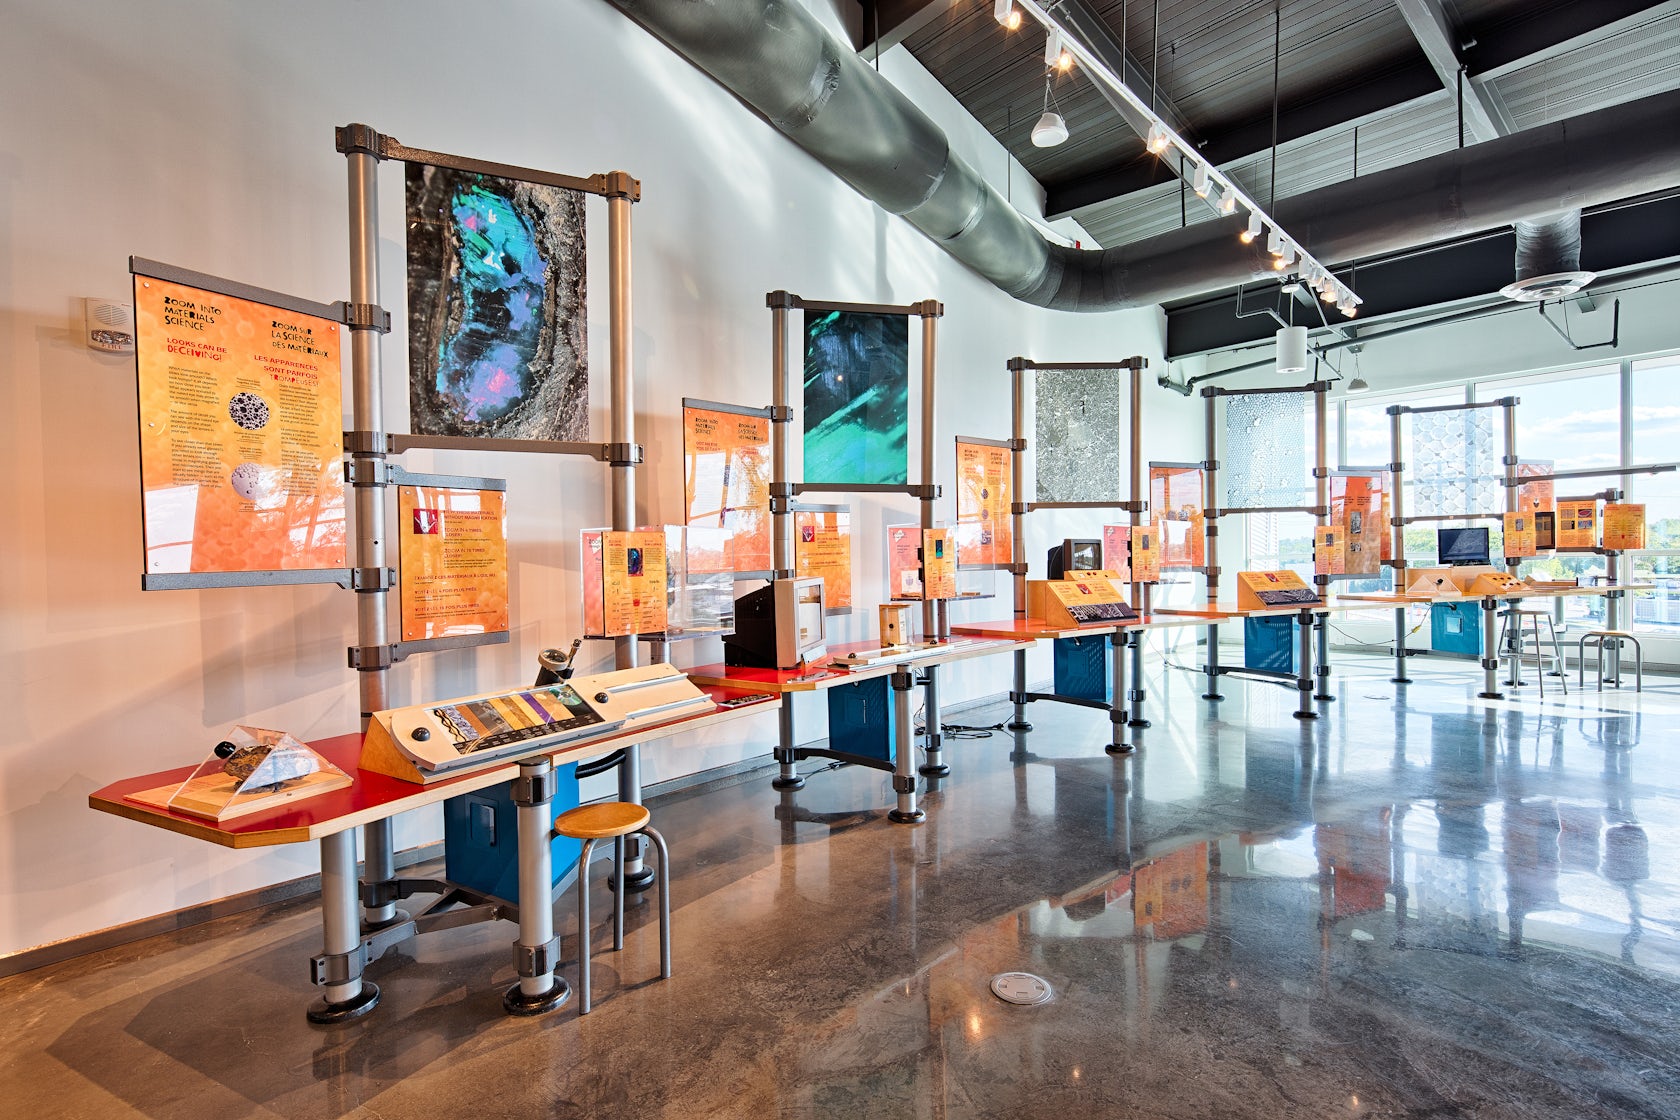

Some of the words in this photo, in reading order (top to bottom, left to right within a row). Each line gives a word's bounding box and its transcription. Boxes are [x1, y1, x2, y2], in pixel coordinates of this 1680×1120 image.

[164, 297, 195, 309] ZOOM
[201, 304, 221, 315] INTO
[165, 306, 214, 324] MATERIALS
[165, 316, 204, 330] SCIENCE
[272, 321, 297, 332] ZOOM
[167, 338, 195, 347] LOOKS
[283, 332, 314, 345] SCIENCE
[168, 345, 222, 362] DECEIVING!
[270, 358, 318, 371] APPARENCES
